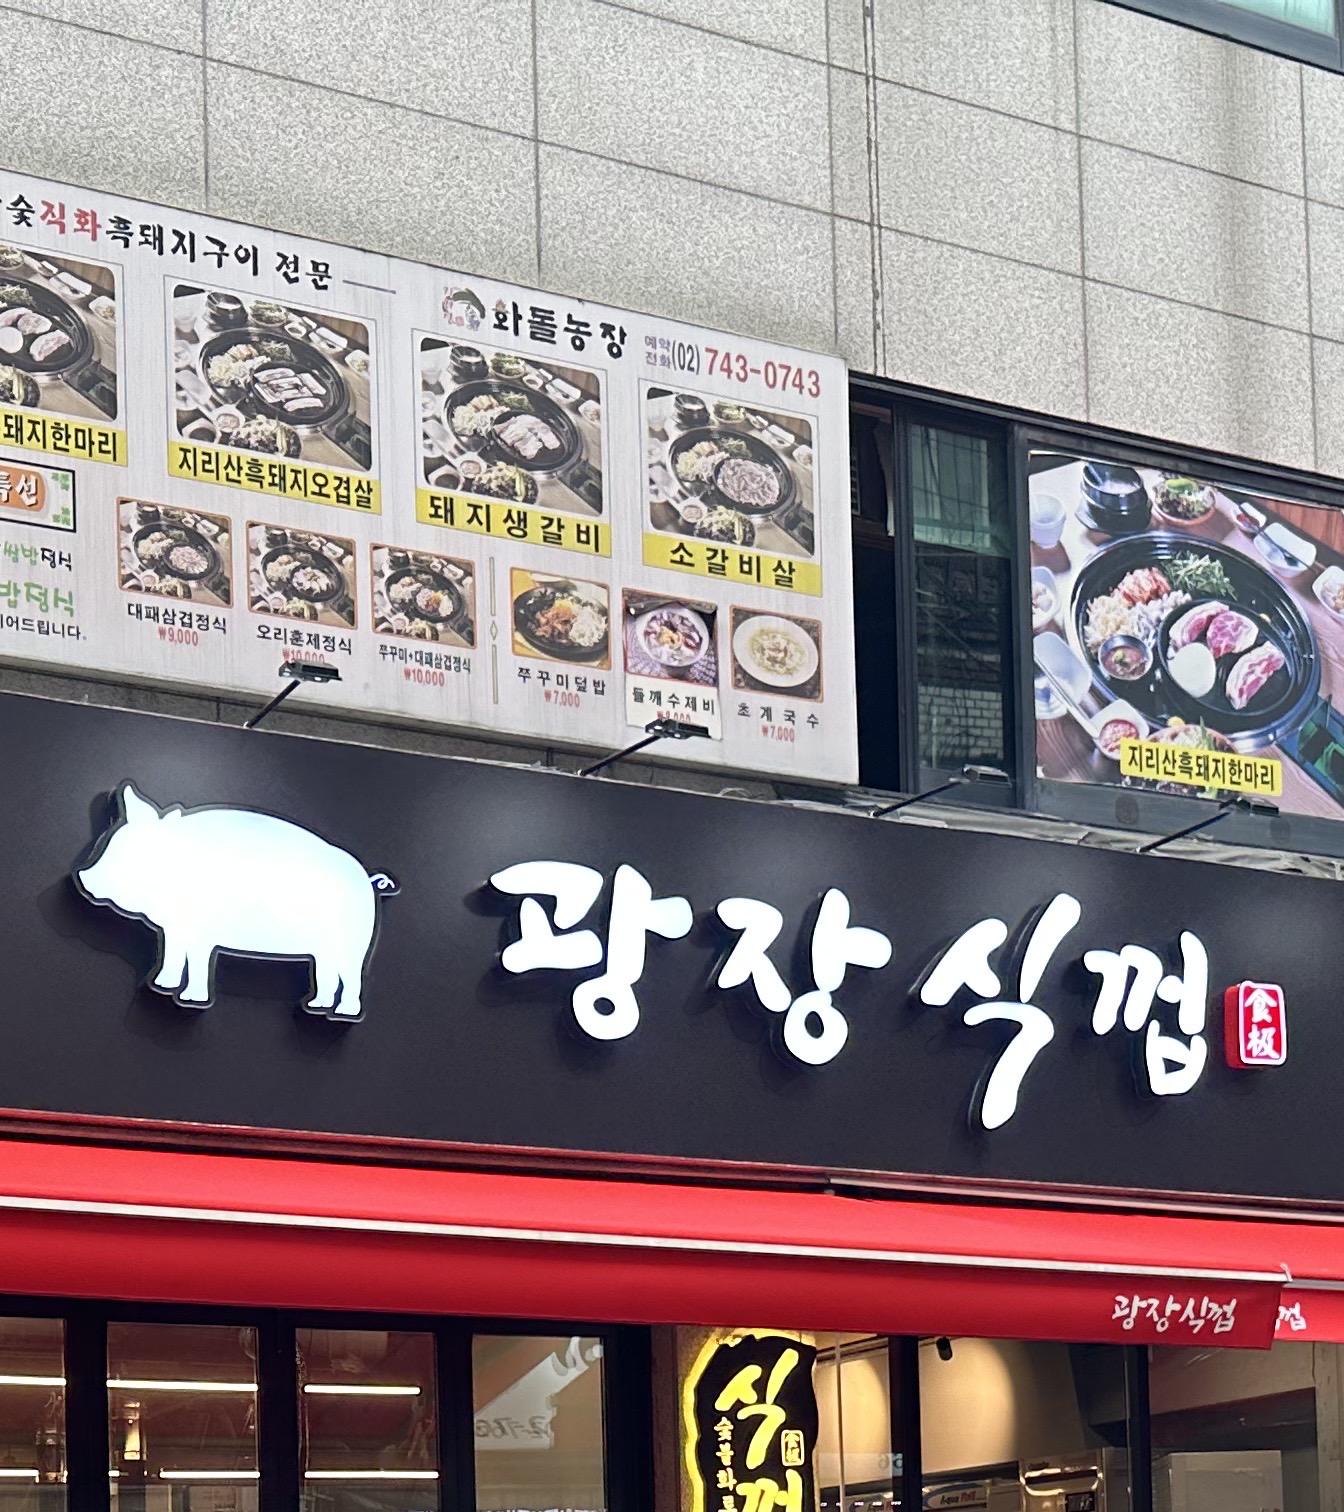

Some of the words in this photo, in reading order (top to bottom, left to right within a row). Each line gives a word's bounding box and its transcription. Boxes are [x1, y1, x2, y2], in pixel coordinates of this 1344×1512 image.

[274, 251, 334, 291] 전문
[492, 298, 629, 360] 화돌농장
[671, 340, 701, 376] (02)
[704, 346, 821, 398] 743-0743
[177, 445, 374, 510] 지리산흑돼지오겹살
[668, 541, 797, 587] 소갈비살
[127, 602, 227, 634] 대패삼겹정식
[256, 624, 353, 655] 오리훈제정식
[737, 703, 820, 729] 초계국수
[1126, 743, 1277, 792] 지리산흑돼지한마리
[488, 858, 1209, 1131] 광장식껍
[1111, 1294, 1237, 1334] 광장식껍
